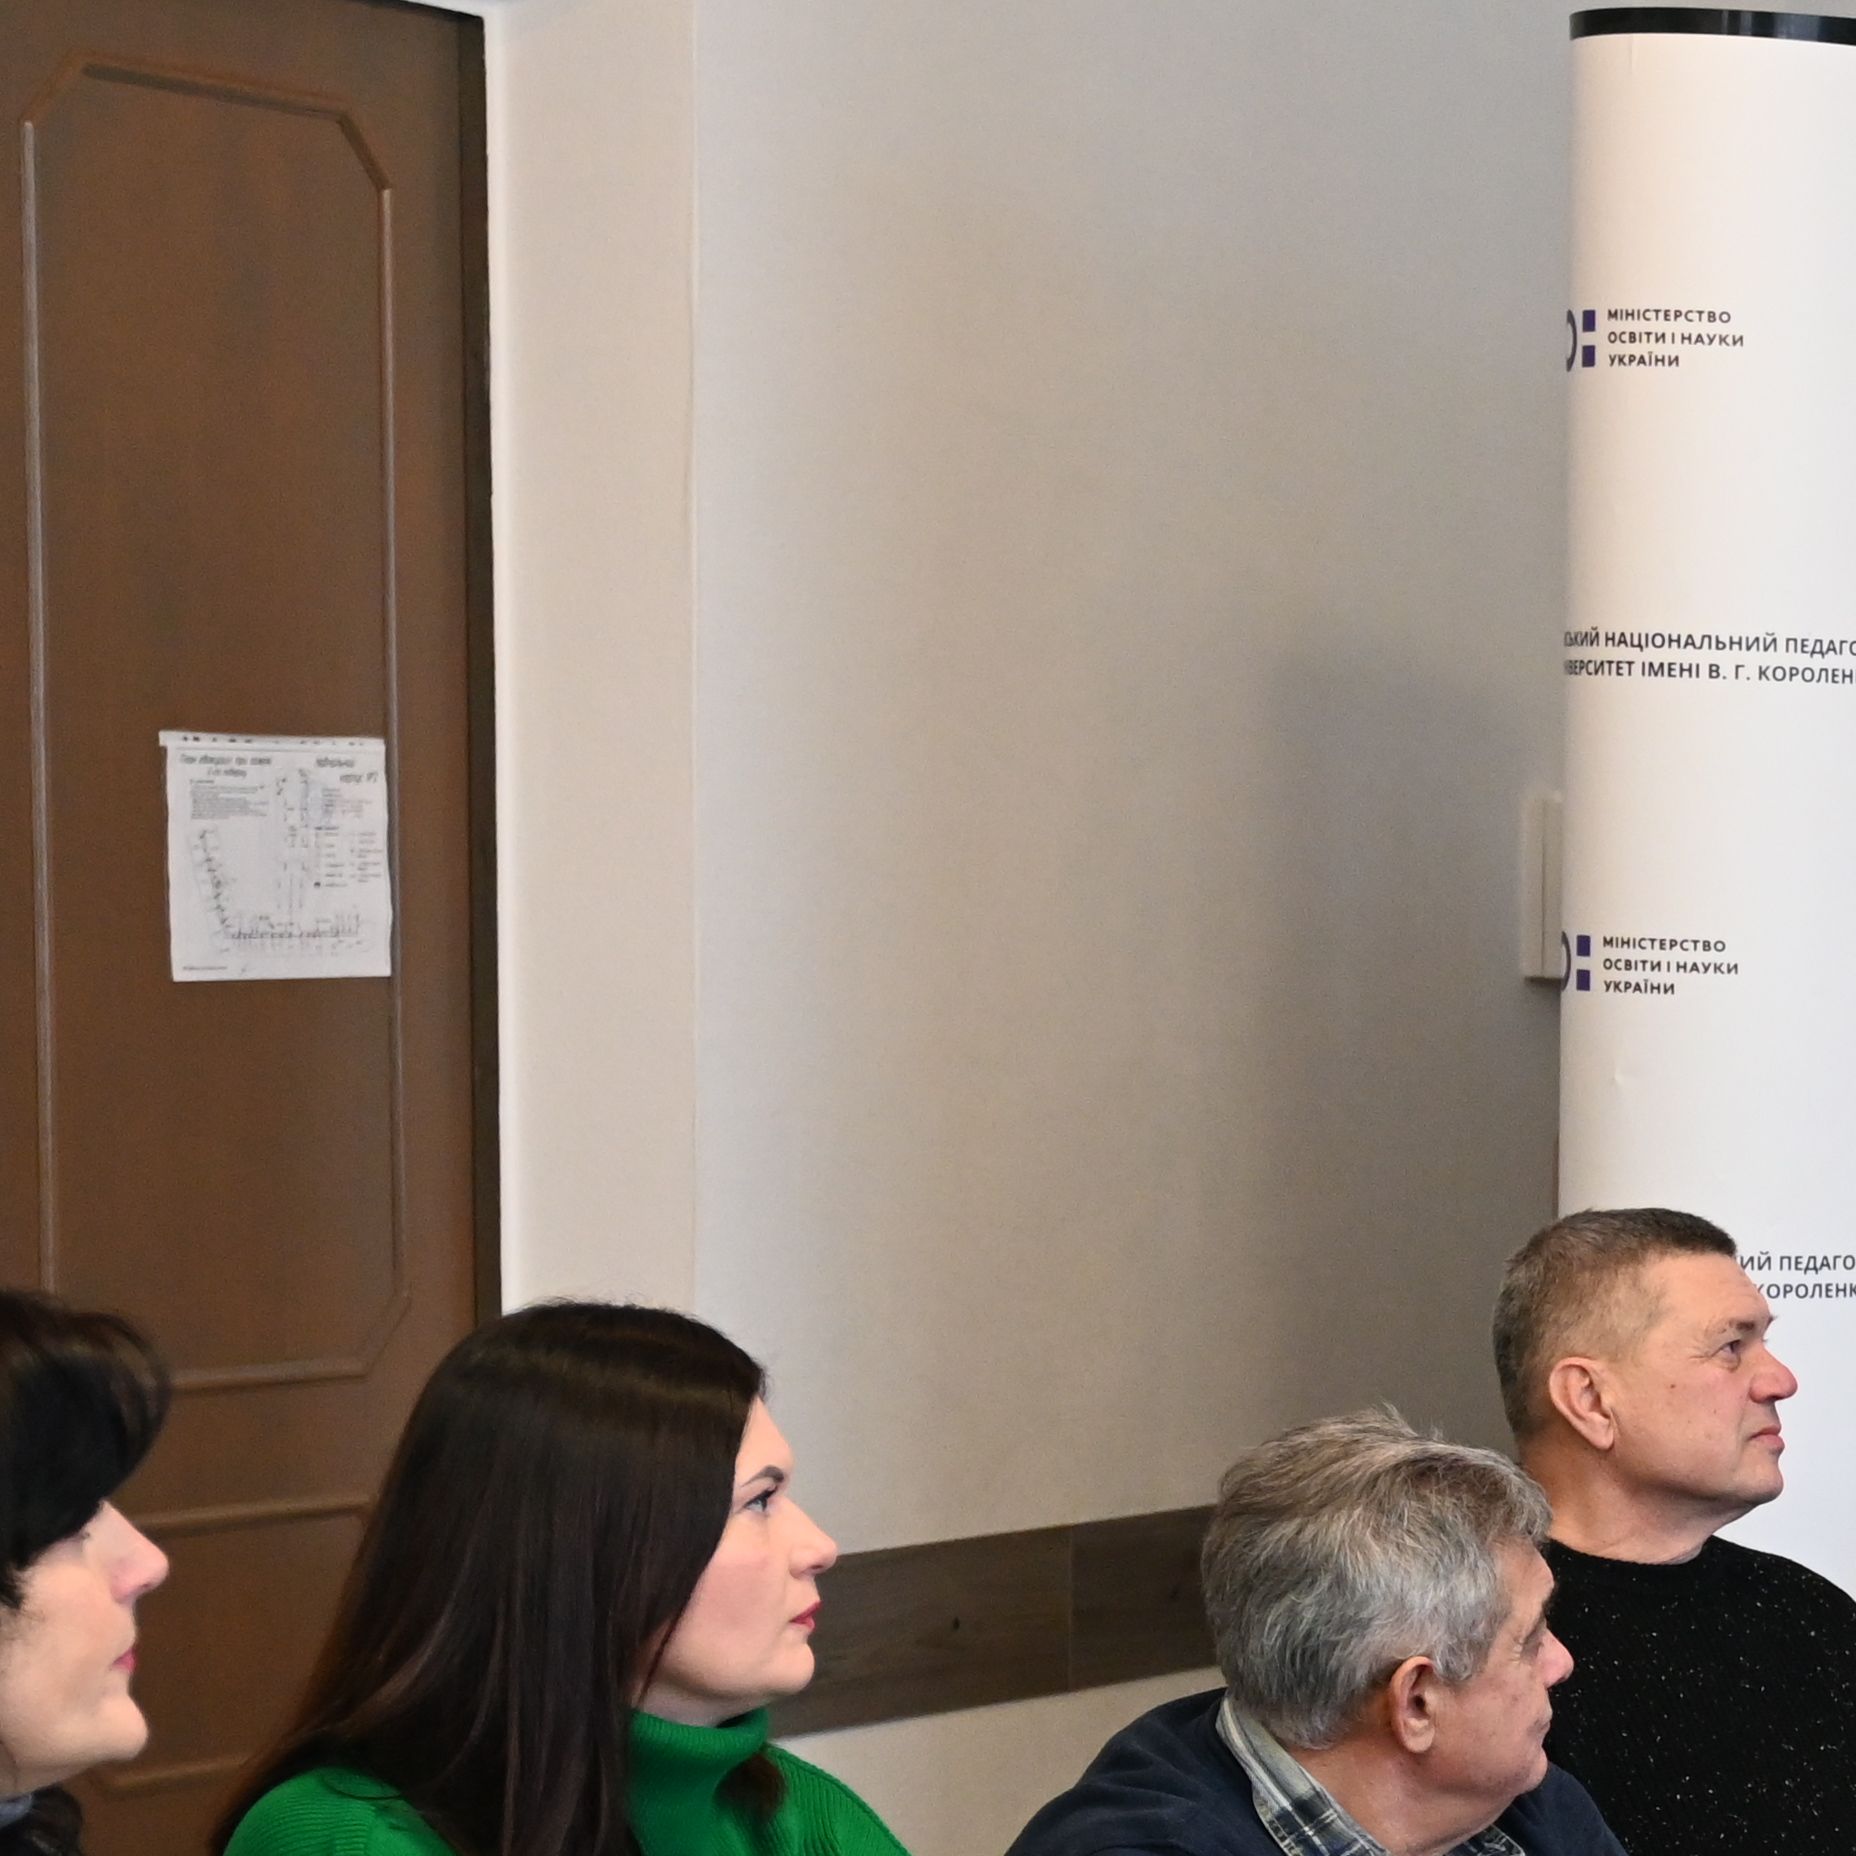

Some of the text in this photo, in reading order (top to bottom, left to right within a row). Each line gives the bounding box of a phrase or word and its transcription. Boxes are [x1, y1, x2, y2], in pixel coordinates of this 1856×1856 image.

[1607, 308, 1732, 324] МІНІСТЕРСТВО
[1607, 330, 1666, 345] ОСВІТИ
[1680, 332, 1744, 347] НАУКИ
[1608, 350, 1680, 368] УКРАЇНИ
[1604, 631, 1778, 653] НАЦІОНАЛЬНИЙ
[1641, 660, 1700, 679] ІМЕНІ
[1708, 663, 1727, 680] В.
[1734, 664, 1751, 681] Г.
[1602, 935, 1727, 953] МІНІСТЕРСТВО
[1602, 957, 1662, 973] ОСВІТИ
[1675, 960, 1739, 975] НАУКИ
[1603, 978, 1675, 995] УКРАЇНИ
